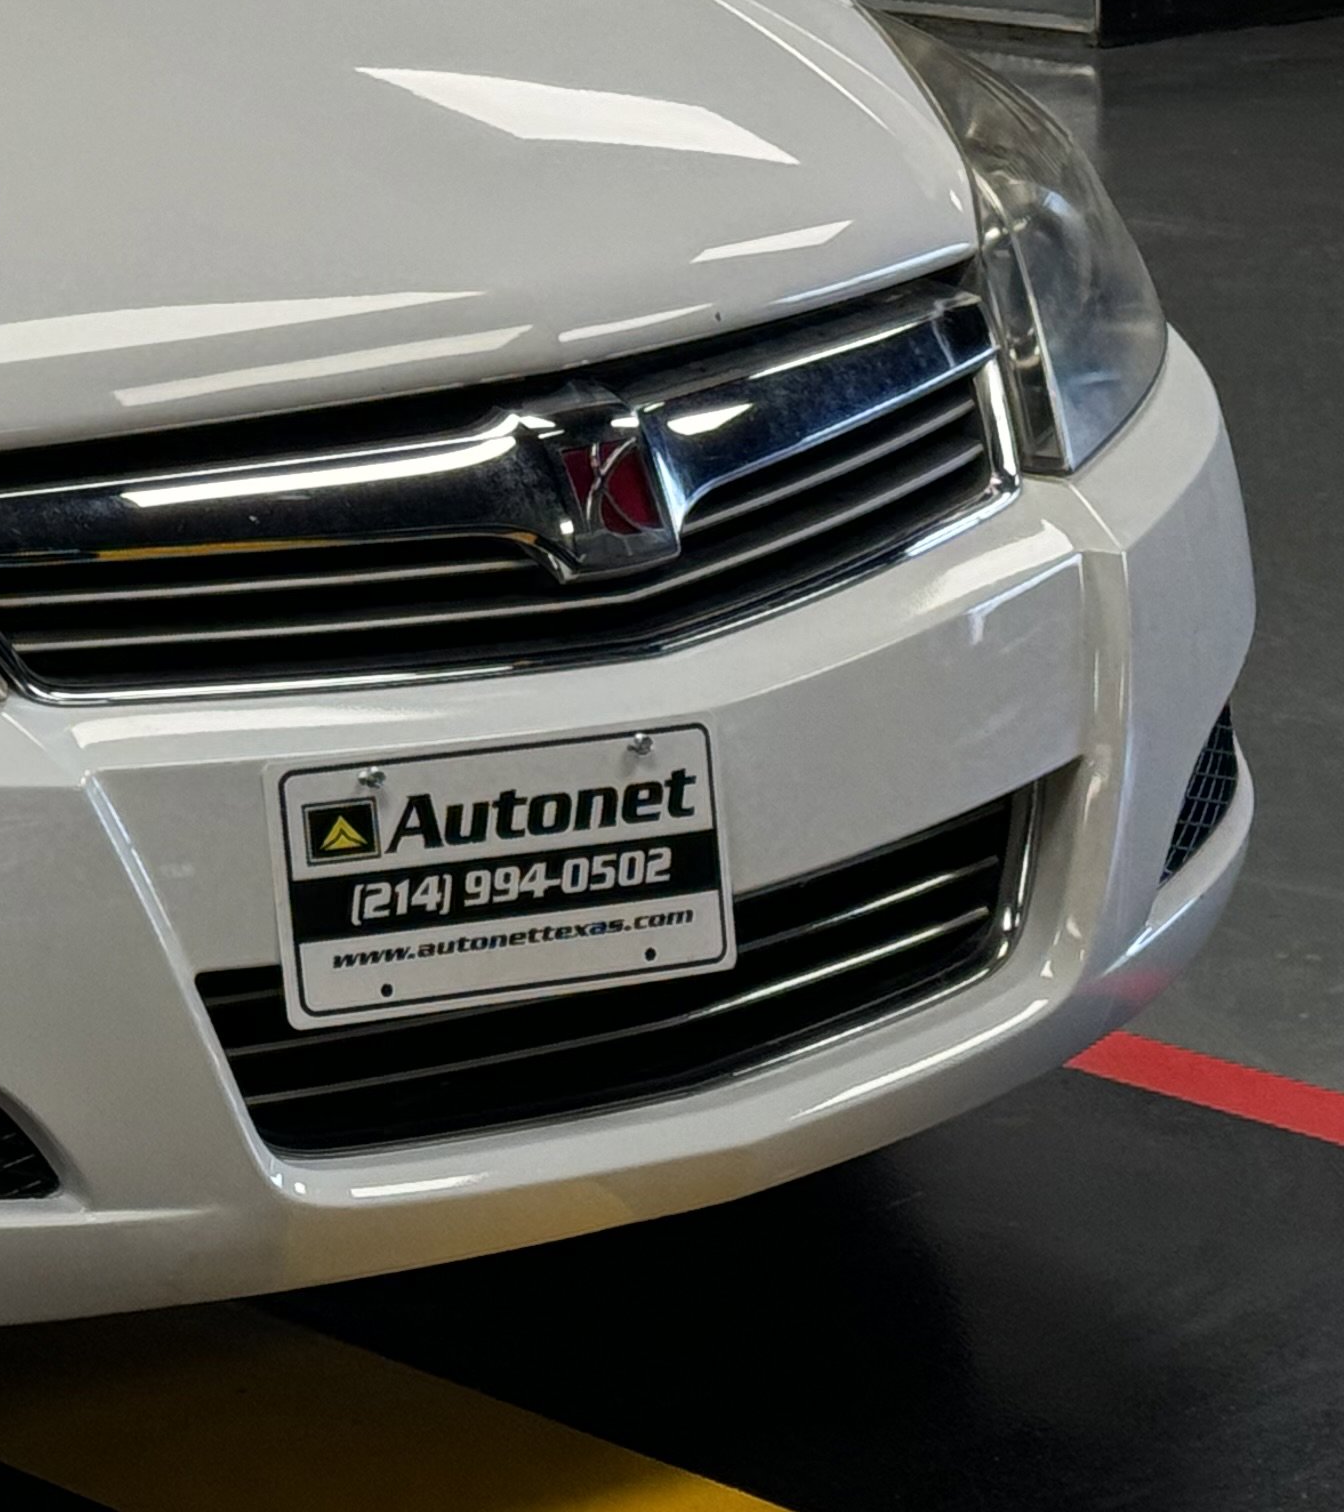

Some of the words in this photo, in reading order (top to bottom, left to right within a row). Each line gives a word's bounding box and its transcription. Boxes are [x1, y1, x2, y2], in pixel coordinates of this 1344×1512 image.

[385, 769, 696, 853] Autonet
[351, 873, 452, 926] (214)
[463, 847, 672, 907] 994-0502
[332, 909, 694, 969] www.autonettexas.com
